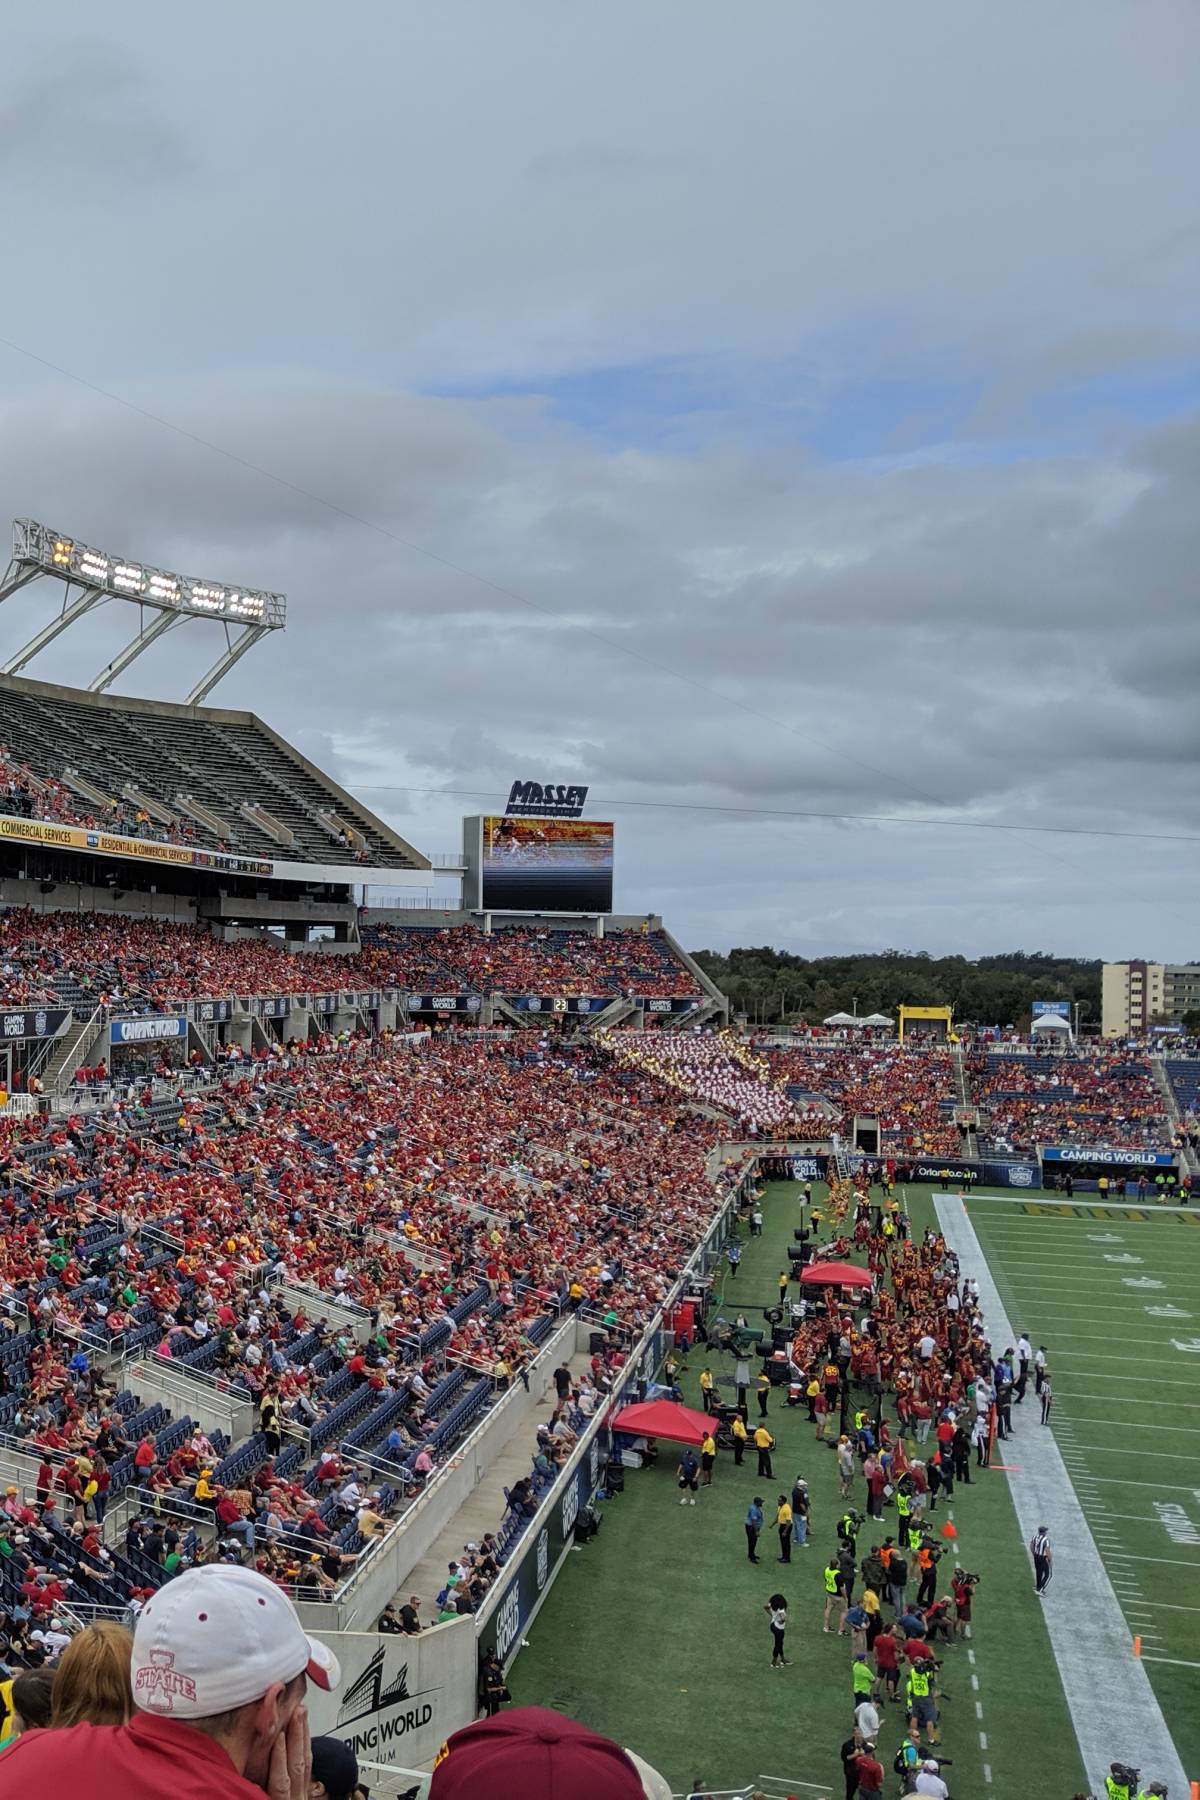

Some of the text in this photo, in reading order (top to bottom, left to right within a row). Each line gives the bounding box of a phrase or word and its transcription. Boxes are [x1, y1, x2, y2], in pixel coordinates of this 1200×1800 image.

[508, 780, 589, 806] MASSEY
[1, 821, 44, 839] COMMERCIAL
[44, 830, 71, 843] SERVICES
[101, 837, 134, 854] RESIDENTIAL
[138, 844, 168, 859] COMMERCIAL
[168, 849, 189, 861] SERVICES
[4, 1015, 25, 1025] CAMPING
[4, 1024, 25, 1035] WORLD
[121, 1020, 179, 1040] CAMPING WORLD
[1060, 1150, 1156, 1164] CAMPING WORLD
[563, 1474, 579, 1516] CAMPING
[563, 1491, 579, 1540] WORLD
[496, 1579, 519, 1637] CAMPING
[496, 1604, 519, 1660] WORLD
[135, 1666, 196, 1702] STATE
[344, 1703, 432, 1755] PING WORLD
